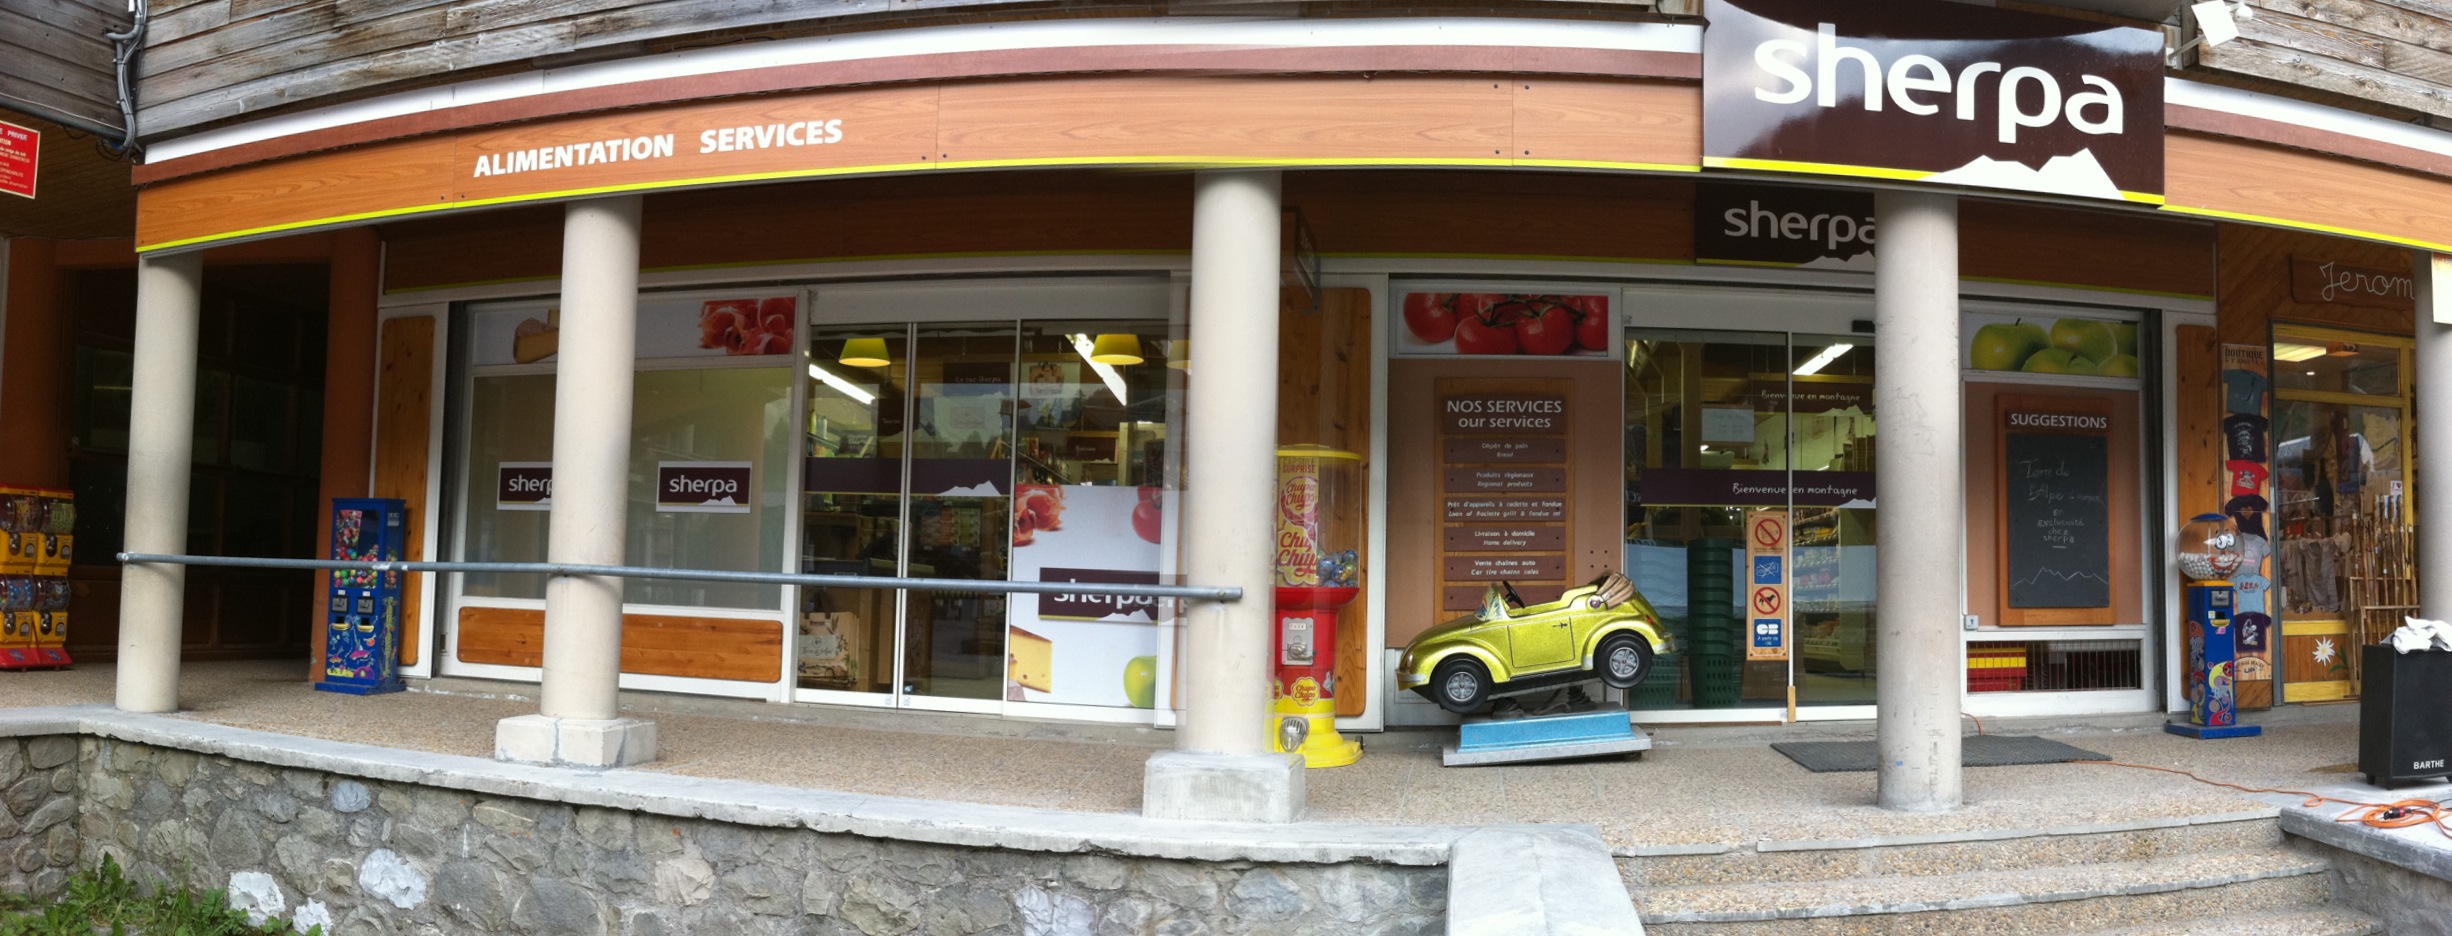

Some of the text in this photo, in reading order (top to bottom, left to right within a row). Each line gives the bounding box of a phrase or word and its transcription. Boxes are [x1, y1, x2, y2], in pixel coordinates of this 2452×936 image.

[1753, 22, 2124, 144] sherpa
[473, 119, 842, 178] ALIMENTATION SERVICES
[1724, 201, 1875, 250] sherpa
[1819, 393, 1860, 403] montagne
[1447, 400, 1562, 413] NOS SERVICES
[1458, 415, 1551, 428] our services
[2010, 413, 2107, 429] SUGGESTIONS
[1282, 465, 1316, 474] SURPRISE
[669, 474, 738, 496] sherpa
[1732, 482, 1786, 495] Bienvenue
[1807, 485, 1858, 498] montagne
[2413, 759, 2444, 770] BARTHE
